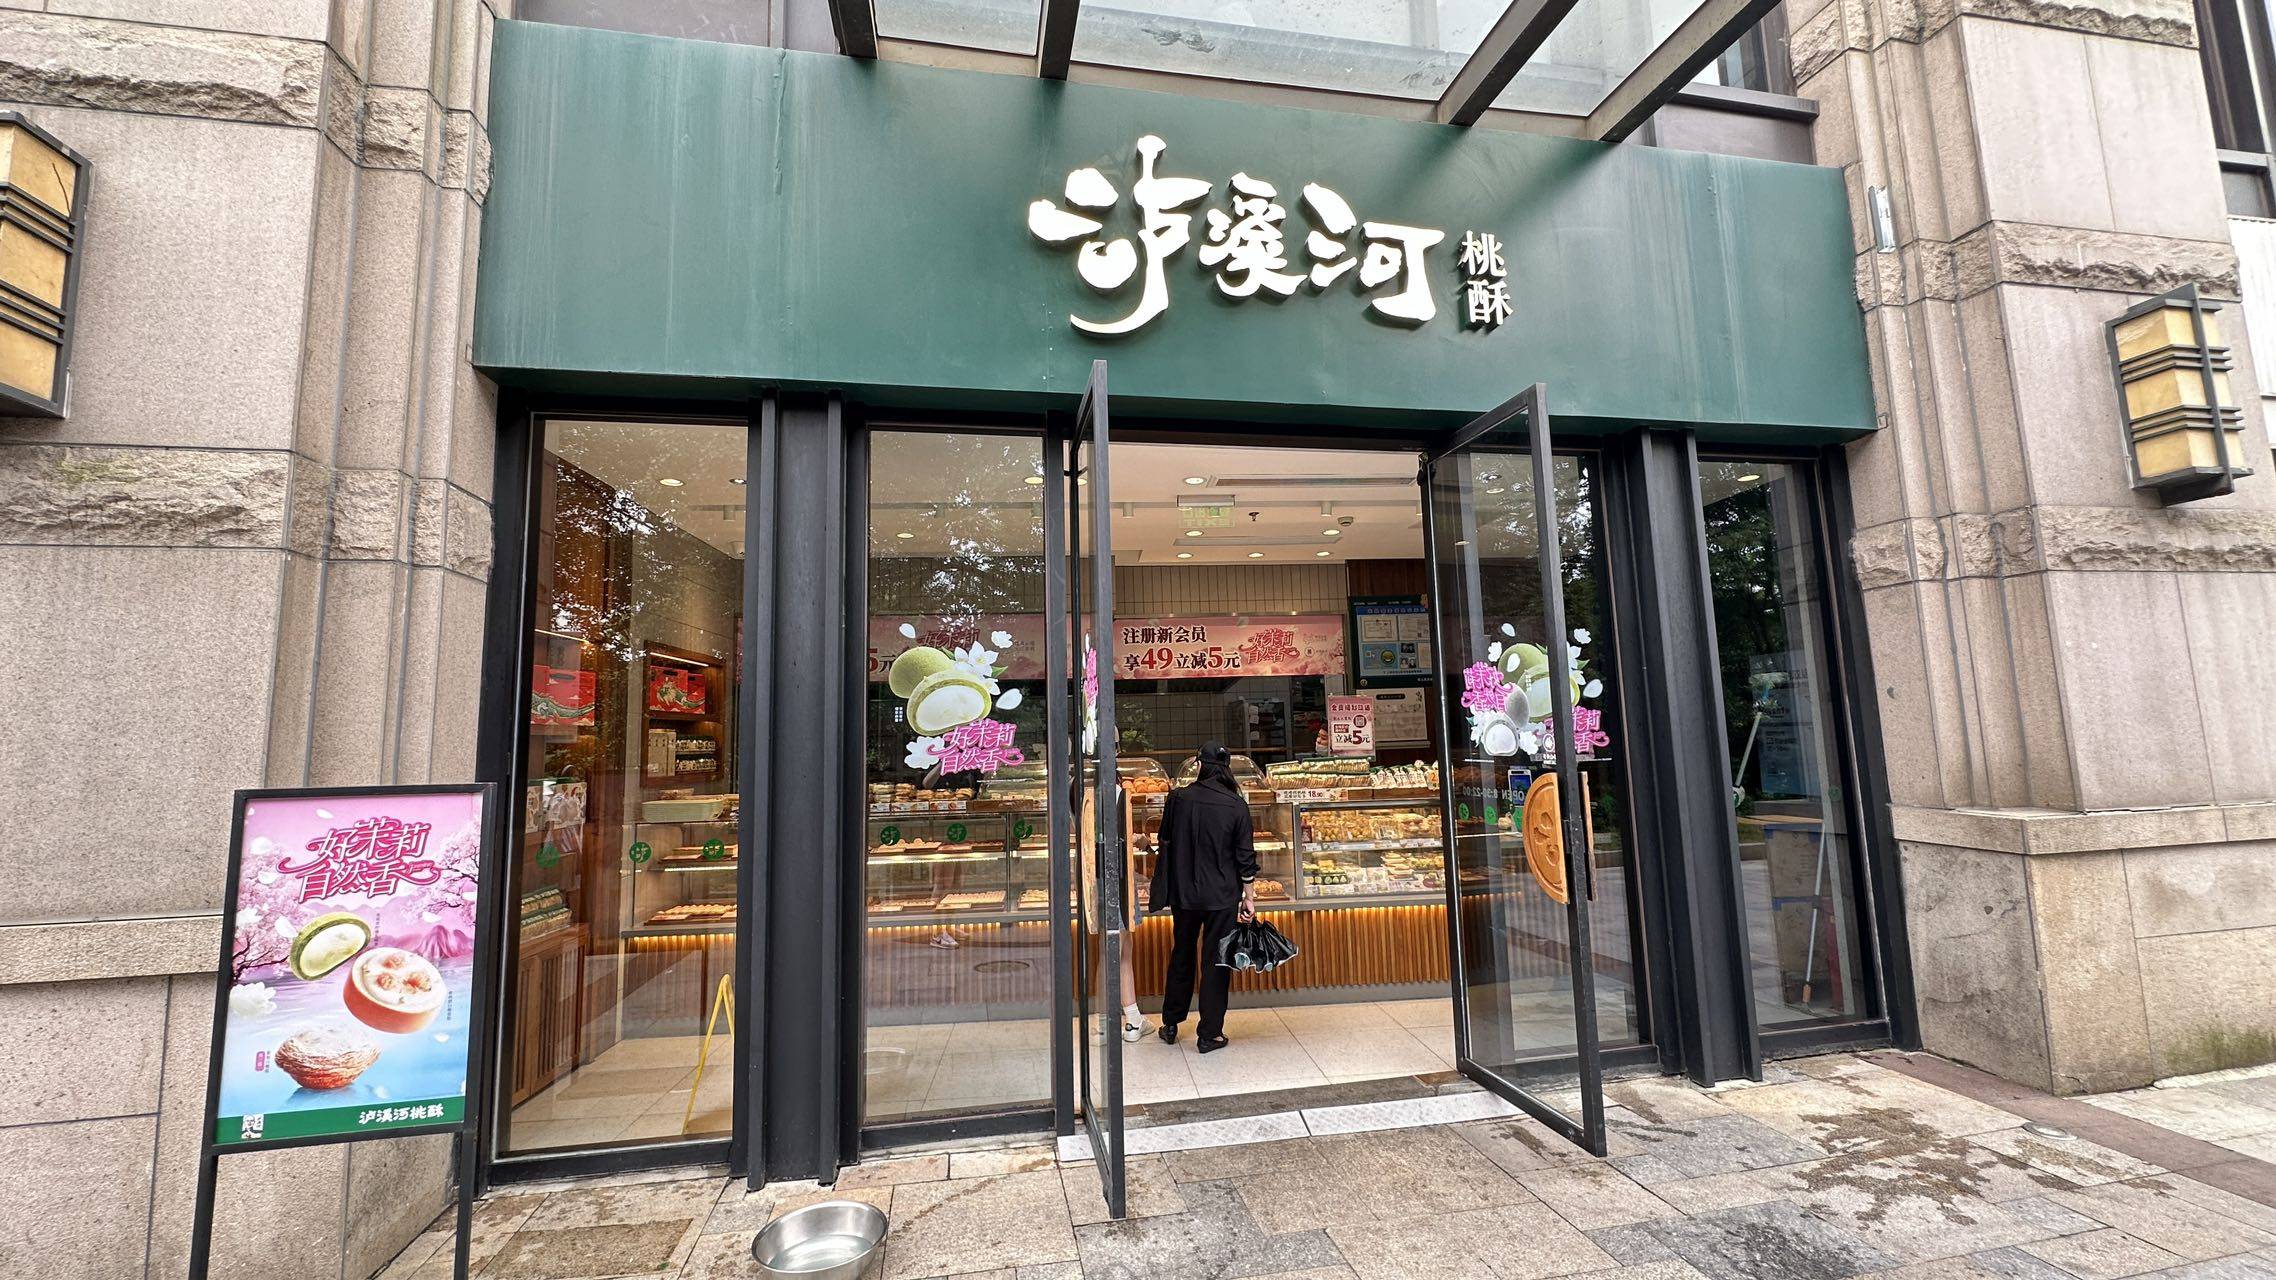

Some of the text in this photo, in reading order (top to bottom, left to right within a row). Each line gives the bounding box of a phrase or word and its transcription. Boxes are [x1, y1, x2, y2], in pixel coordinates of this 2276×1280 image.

[1029, 135, 1445, 334] 泸溪河
[1461, 230, 1513, 326] 桃酥
[1123, 625, 1207, 645] 注册新会员
[1124, 646, 1241, 672] 享49立减5元
[943, 719, 1018, 749] 好茉莉
[940, 746, 1020, 776] 自然香
[304, 816, 431, 861] 好茉莉
[298, 858, 434, 902] 自然香
[359, 1103, 445, 1125] 泸溪河桃酥
